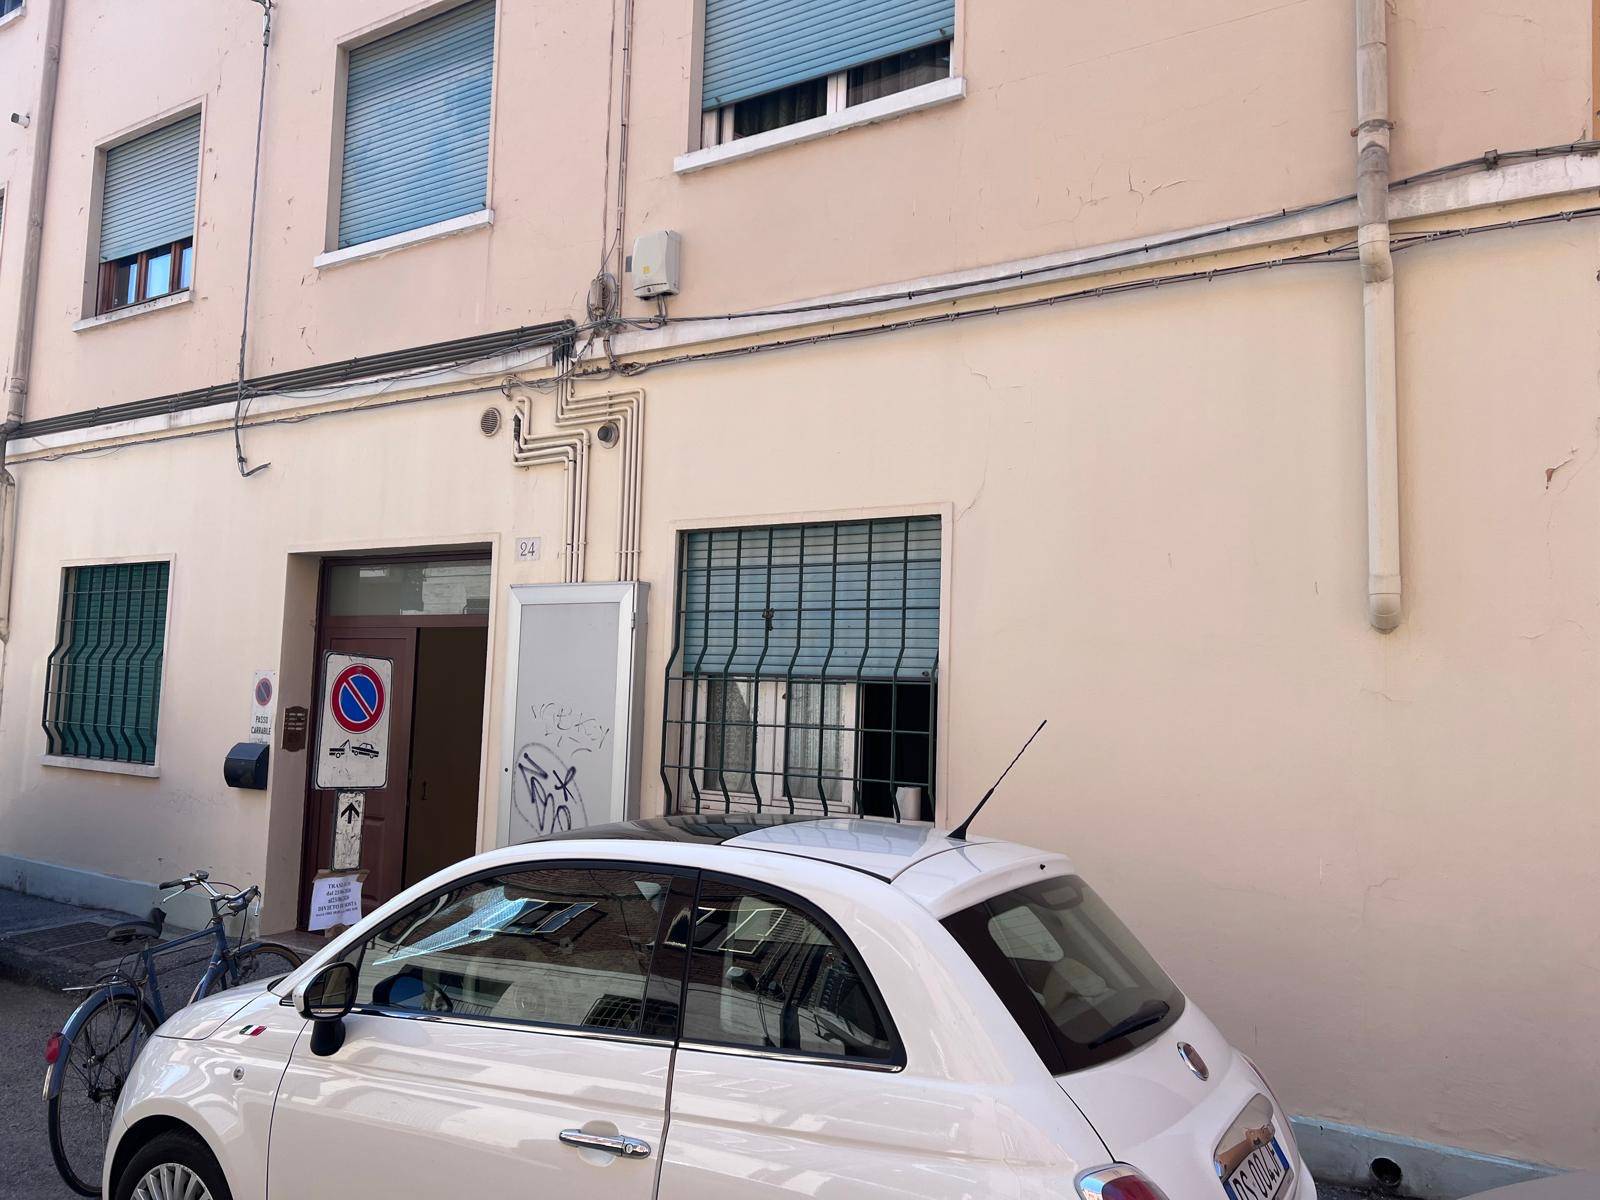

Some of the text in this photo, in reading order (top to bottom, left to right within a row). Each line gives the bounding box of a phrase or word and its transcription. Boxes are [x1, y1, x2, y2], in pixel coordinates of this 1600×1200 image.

[520, 541, 535, 556] 24
[256, 716, 268, 724] PASSO
[251, 726, 272, 735] CARRABILE
